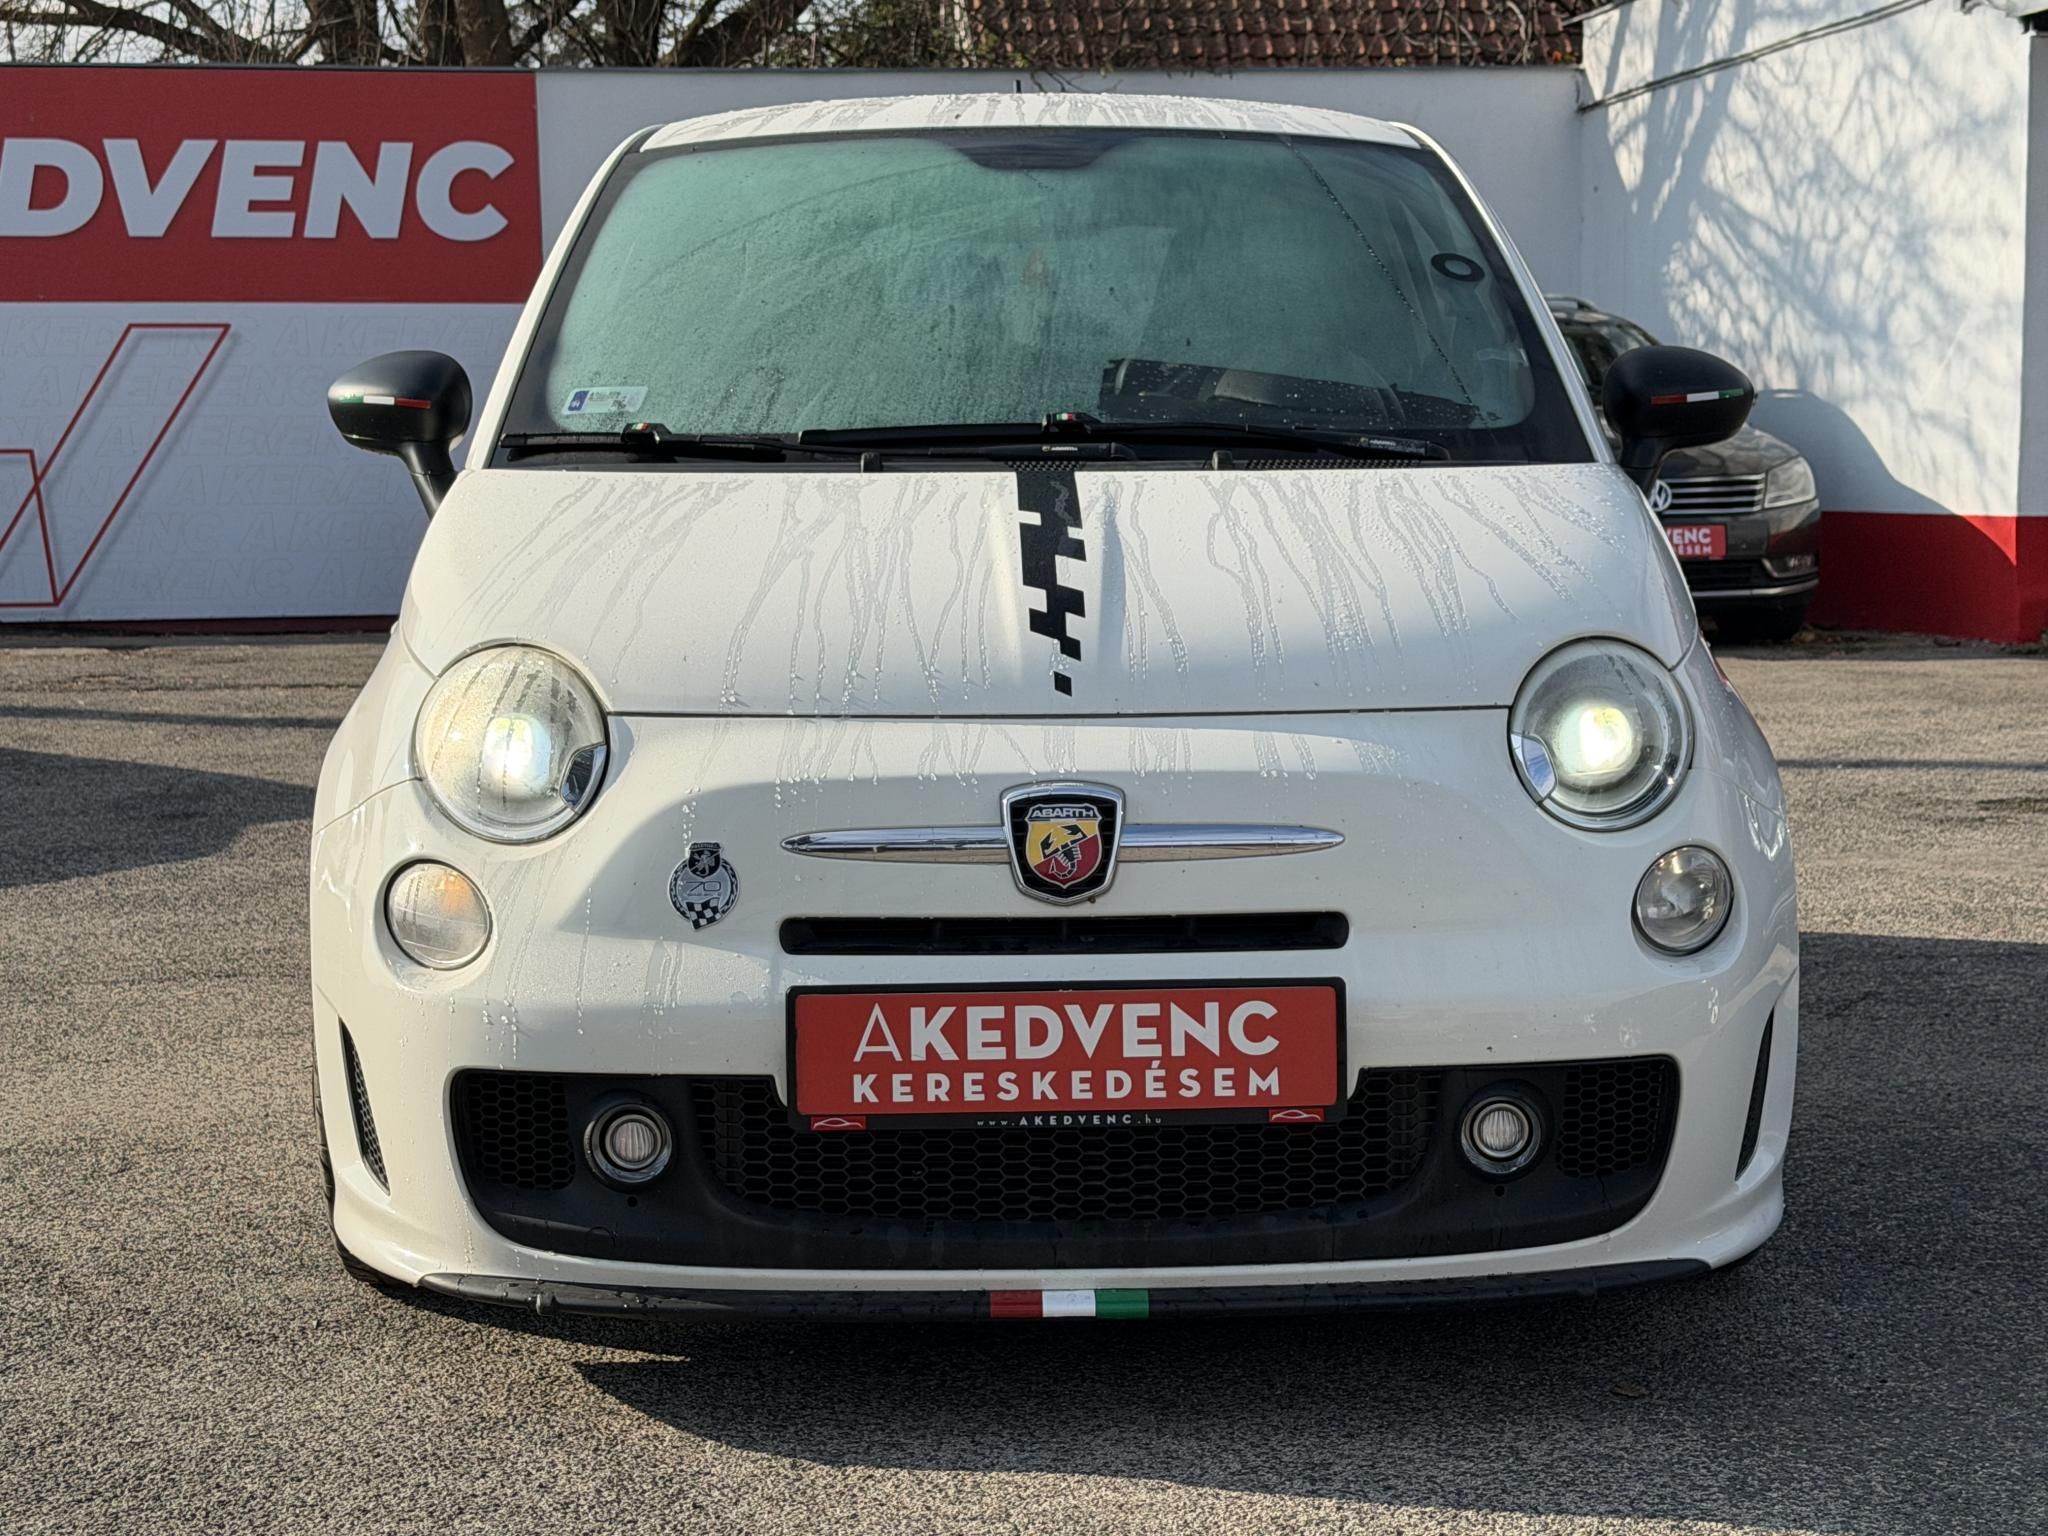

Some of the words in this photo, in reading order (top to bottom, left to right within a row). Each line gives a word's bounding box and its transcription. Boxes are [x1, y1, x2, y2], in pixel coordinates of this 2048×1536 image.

[0, 137, 515, 241] DVENC
[1032, 808, 1094, 818] ABARTH
[853, 1001, 1280, 1062] AKEDVENC
[853, 1061, 1280, 1103] KERESKEDÉSEM
[977, 1114, 1162, 1126] www.AKEDVENC.hu
